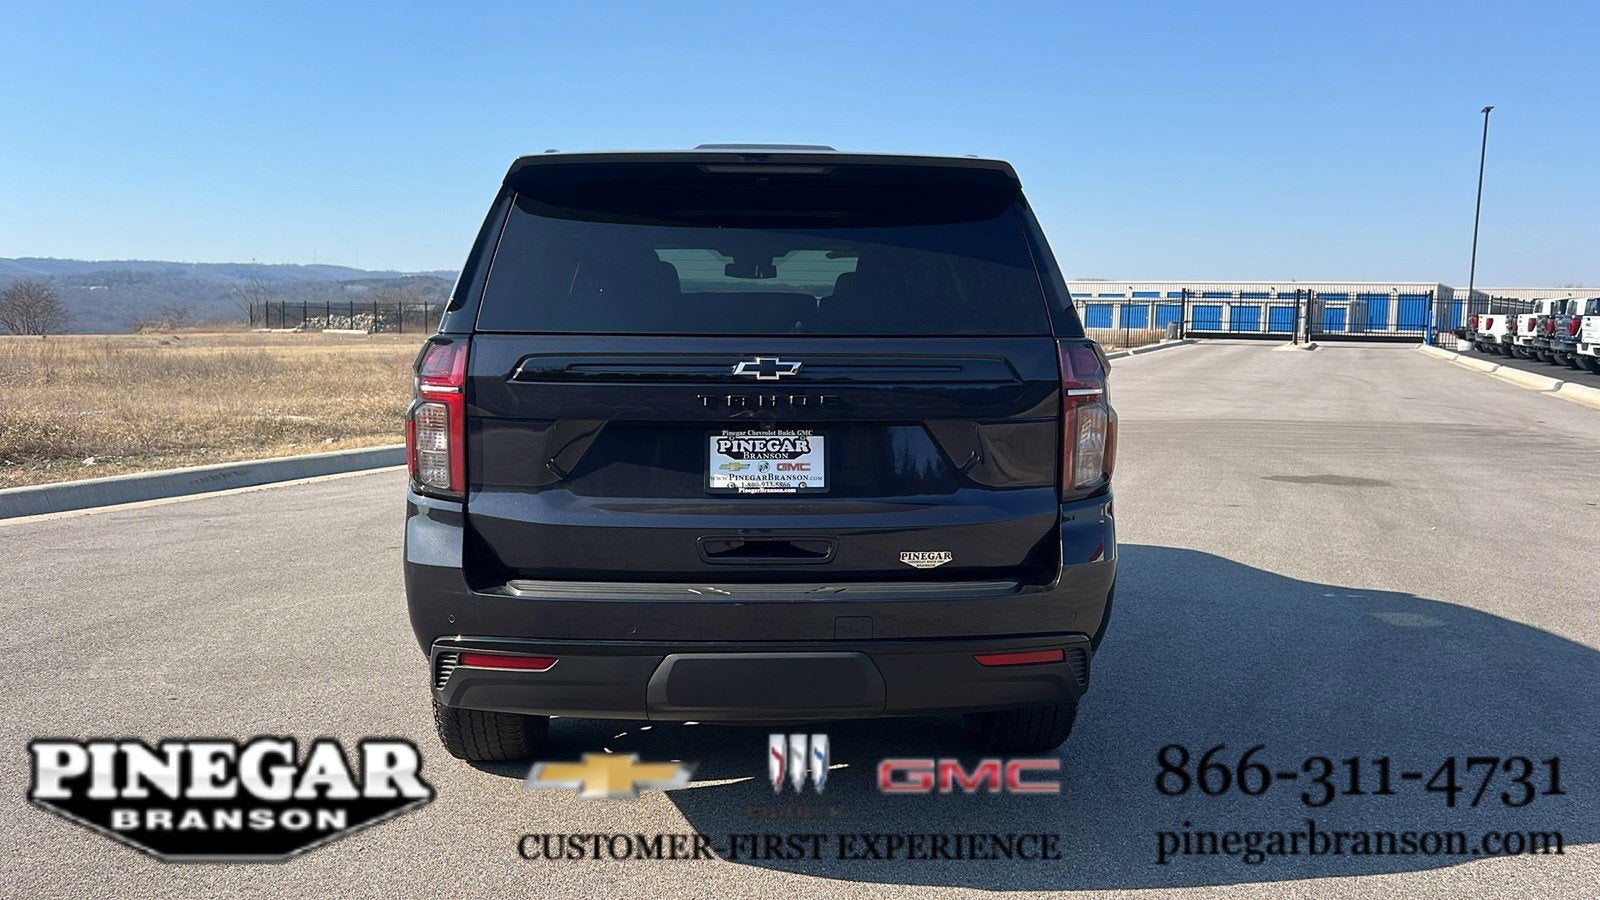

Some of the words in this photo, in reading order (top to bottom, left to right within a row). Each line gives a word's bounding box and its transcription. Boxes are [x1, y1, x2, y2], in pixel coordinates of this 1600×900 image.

[718, 440, 810, 452] PINEGAR
[743, 451, 789, 460] BRANSON
[776, 462, 812, 472] GMC
[901, 552, 952, 560] PINEGAR
